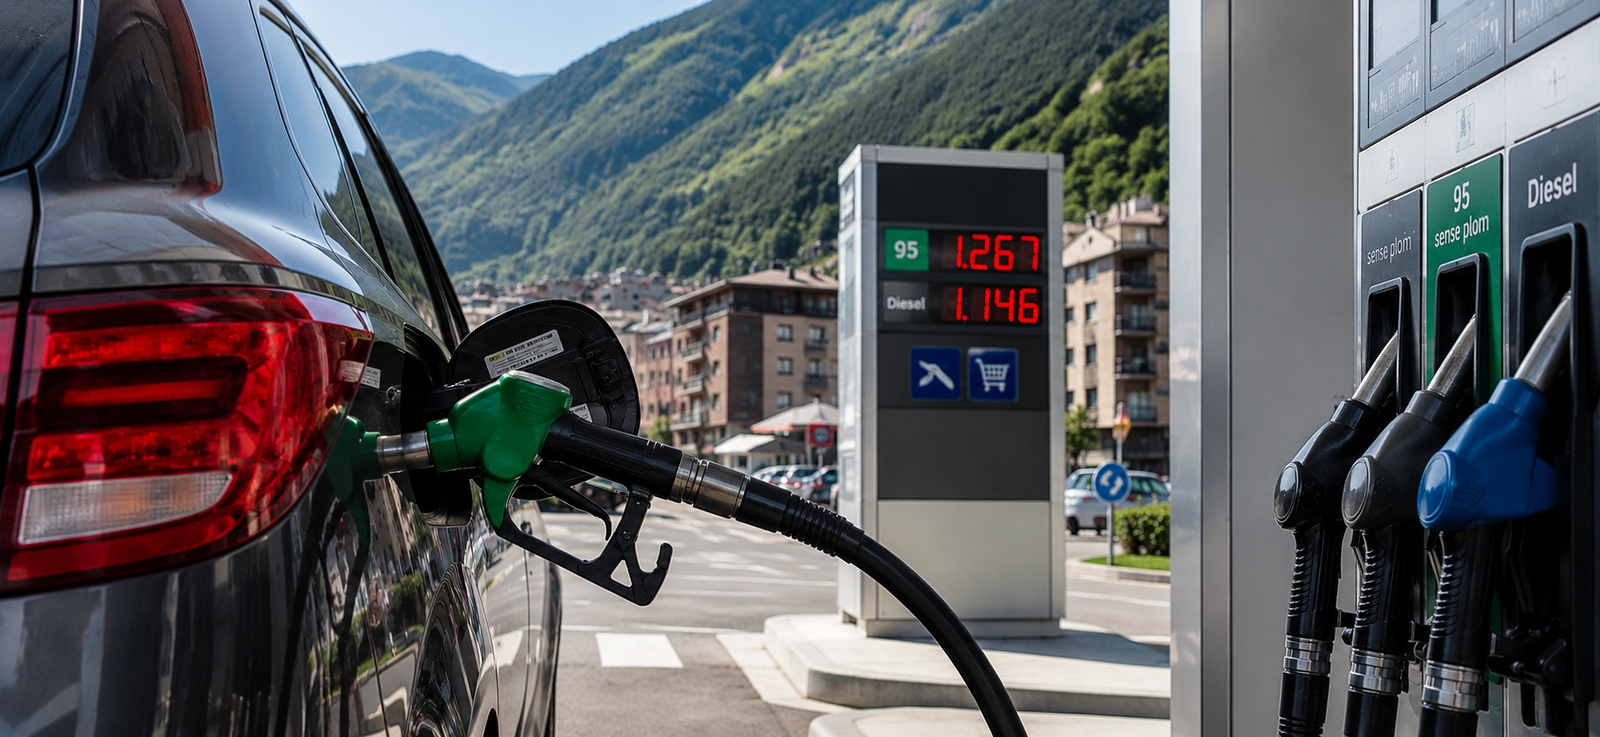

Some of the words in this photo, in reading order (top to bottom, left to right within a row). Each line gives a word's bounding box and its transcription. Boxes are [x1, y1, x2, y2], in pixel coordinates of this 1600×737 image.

[1453, 181, 1470, 213] 95
[1527, 163, 1578, 209] Diesel
[1434, 225, 1461, 248] sense
[1463, 215, 1490, 245] plom
[894, 240, 918, 259] 95
[956, 234, 1039, 271] 1.267
[1367, 245, 1388, 265] sense
[1390, 234, 1412, 263] plom
[886, 296, 926, 311] Diesel
[956, 287, 1039, 324] 1.146
